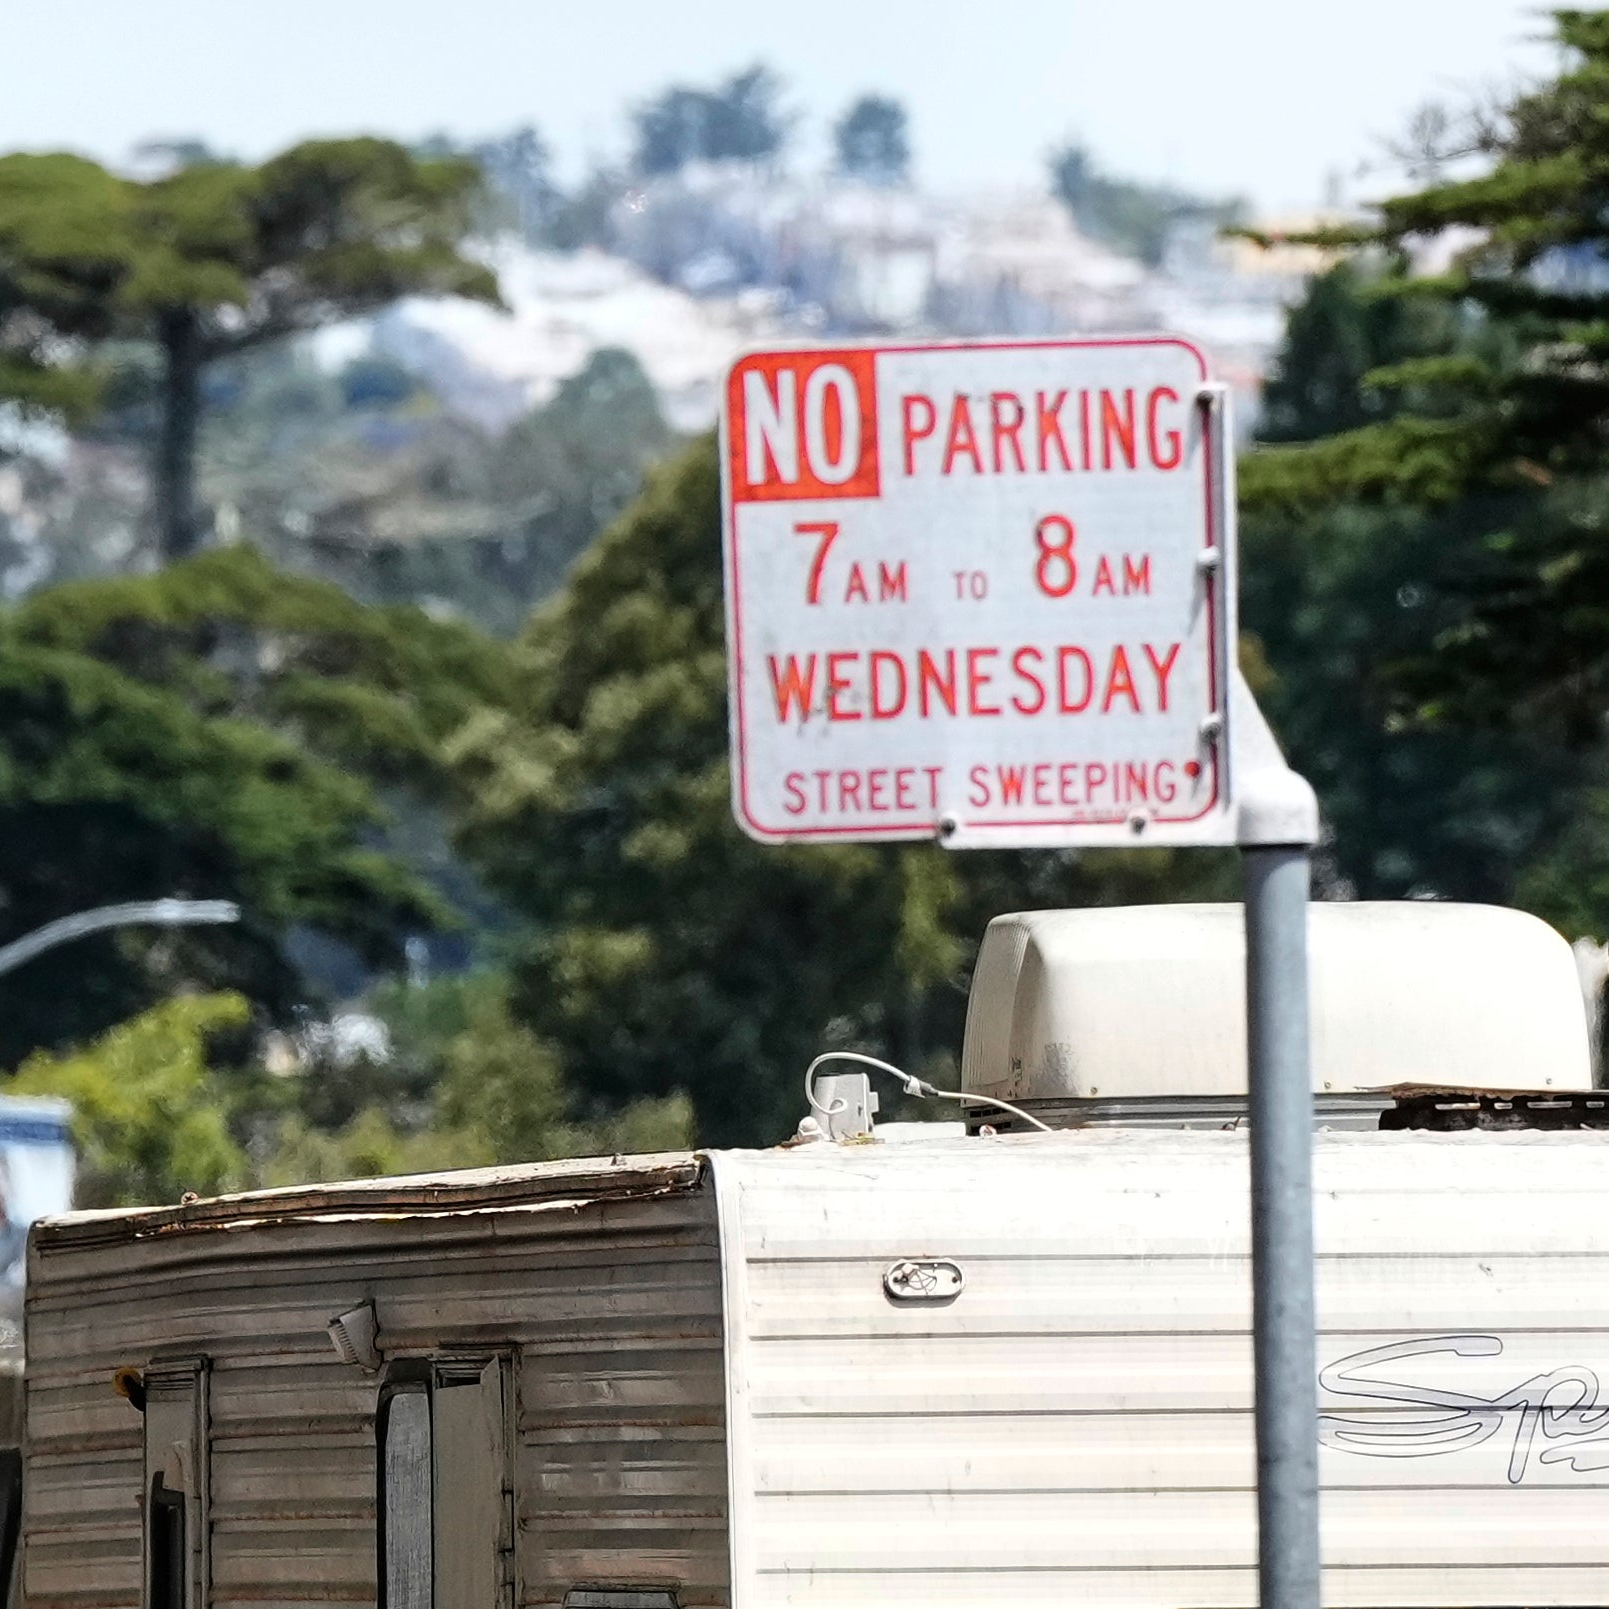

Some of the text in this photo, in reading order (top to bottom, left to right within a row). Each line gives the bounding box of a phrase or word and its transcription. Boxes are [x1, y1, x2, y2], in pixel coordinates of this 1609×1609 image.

[744, 364, 1183, 486] NO PARKING
[955, 574, 988, 600] TO
[767, 643, 1181, 724] WEDNESDAY
[784, 762, 1176, 815] STREET SWEEPING
